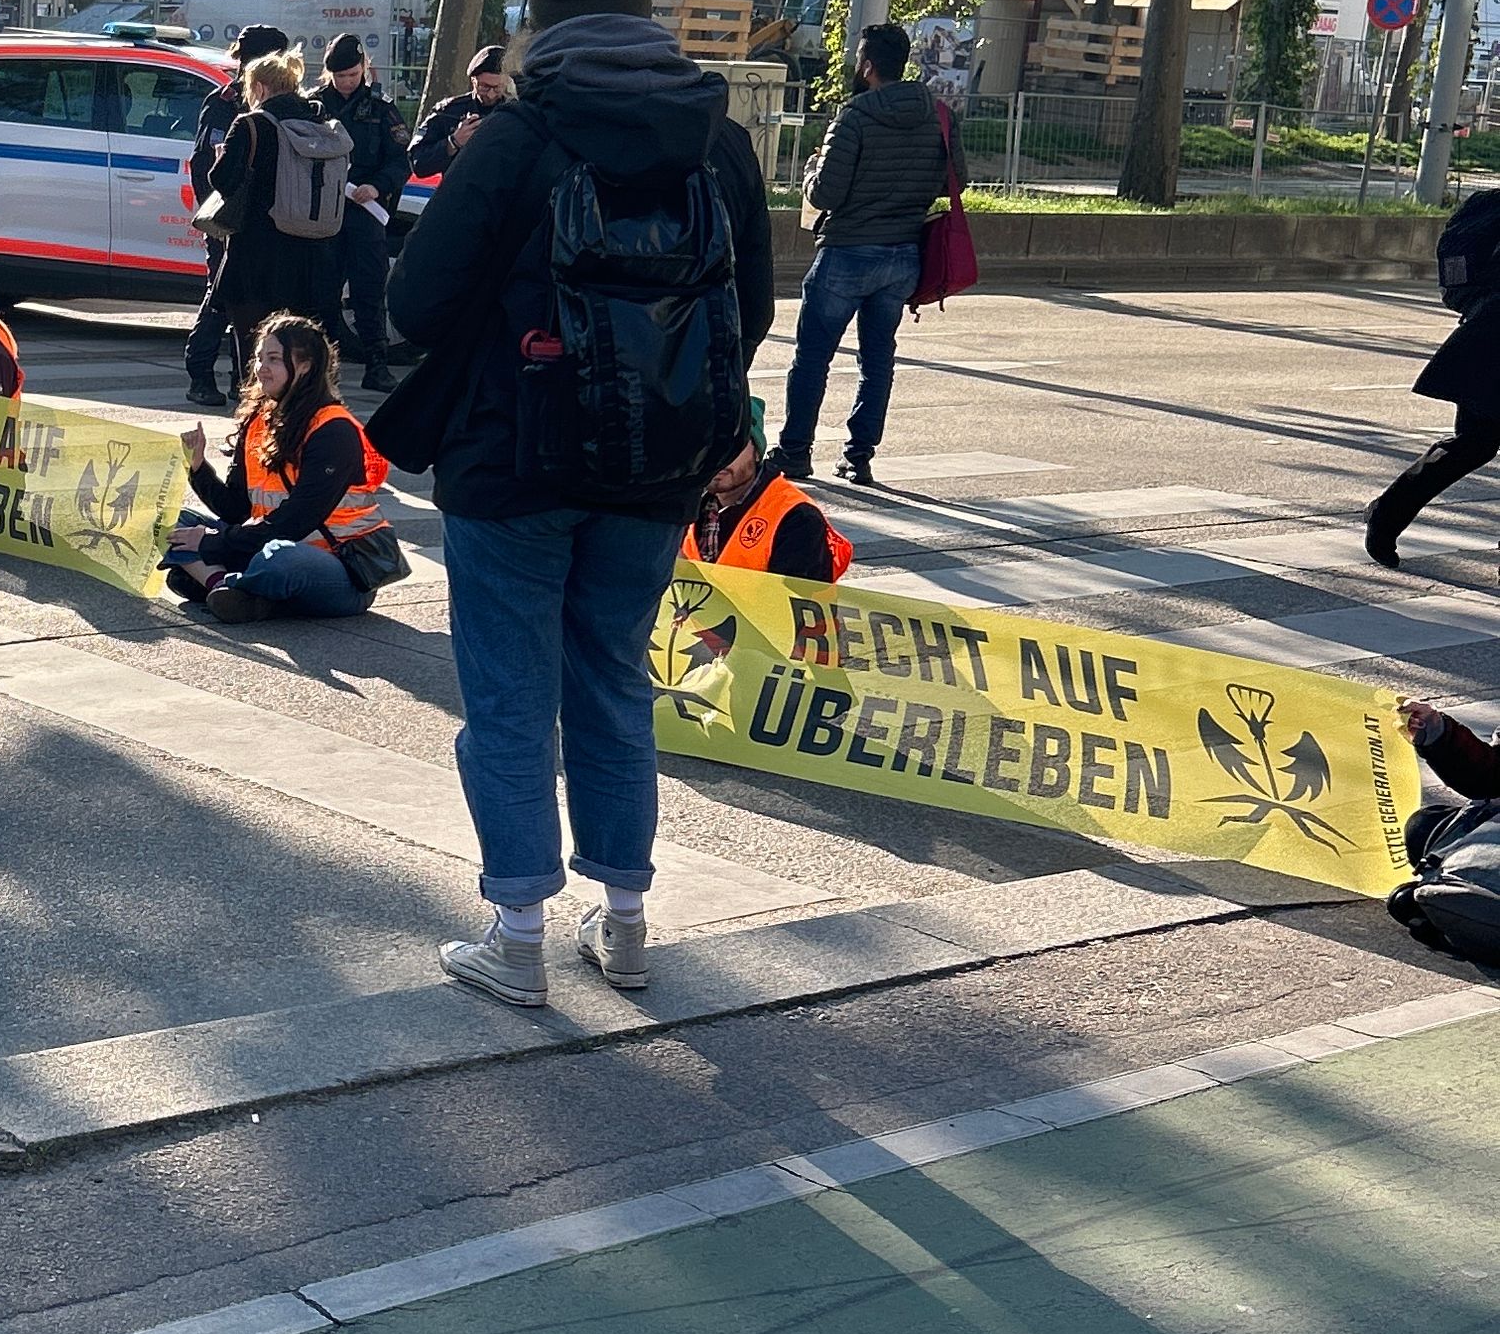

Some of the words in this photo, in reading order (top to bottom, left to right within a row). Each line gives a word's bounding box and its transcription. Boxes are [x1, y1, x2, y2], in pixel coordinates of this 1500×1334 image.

[322, 7, 375, 18] STRABAG
[789, 596, 991, 693] RECHT
[1019, 637, 1139, 723] AUF
[748, 663, 1172, 820] ÜBERLEBEN
[1363, 713, 1399, 824] GENERATION.AT
